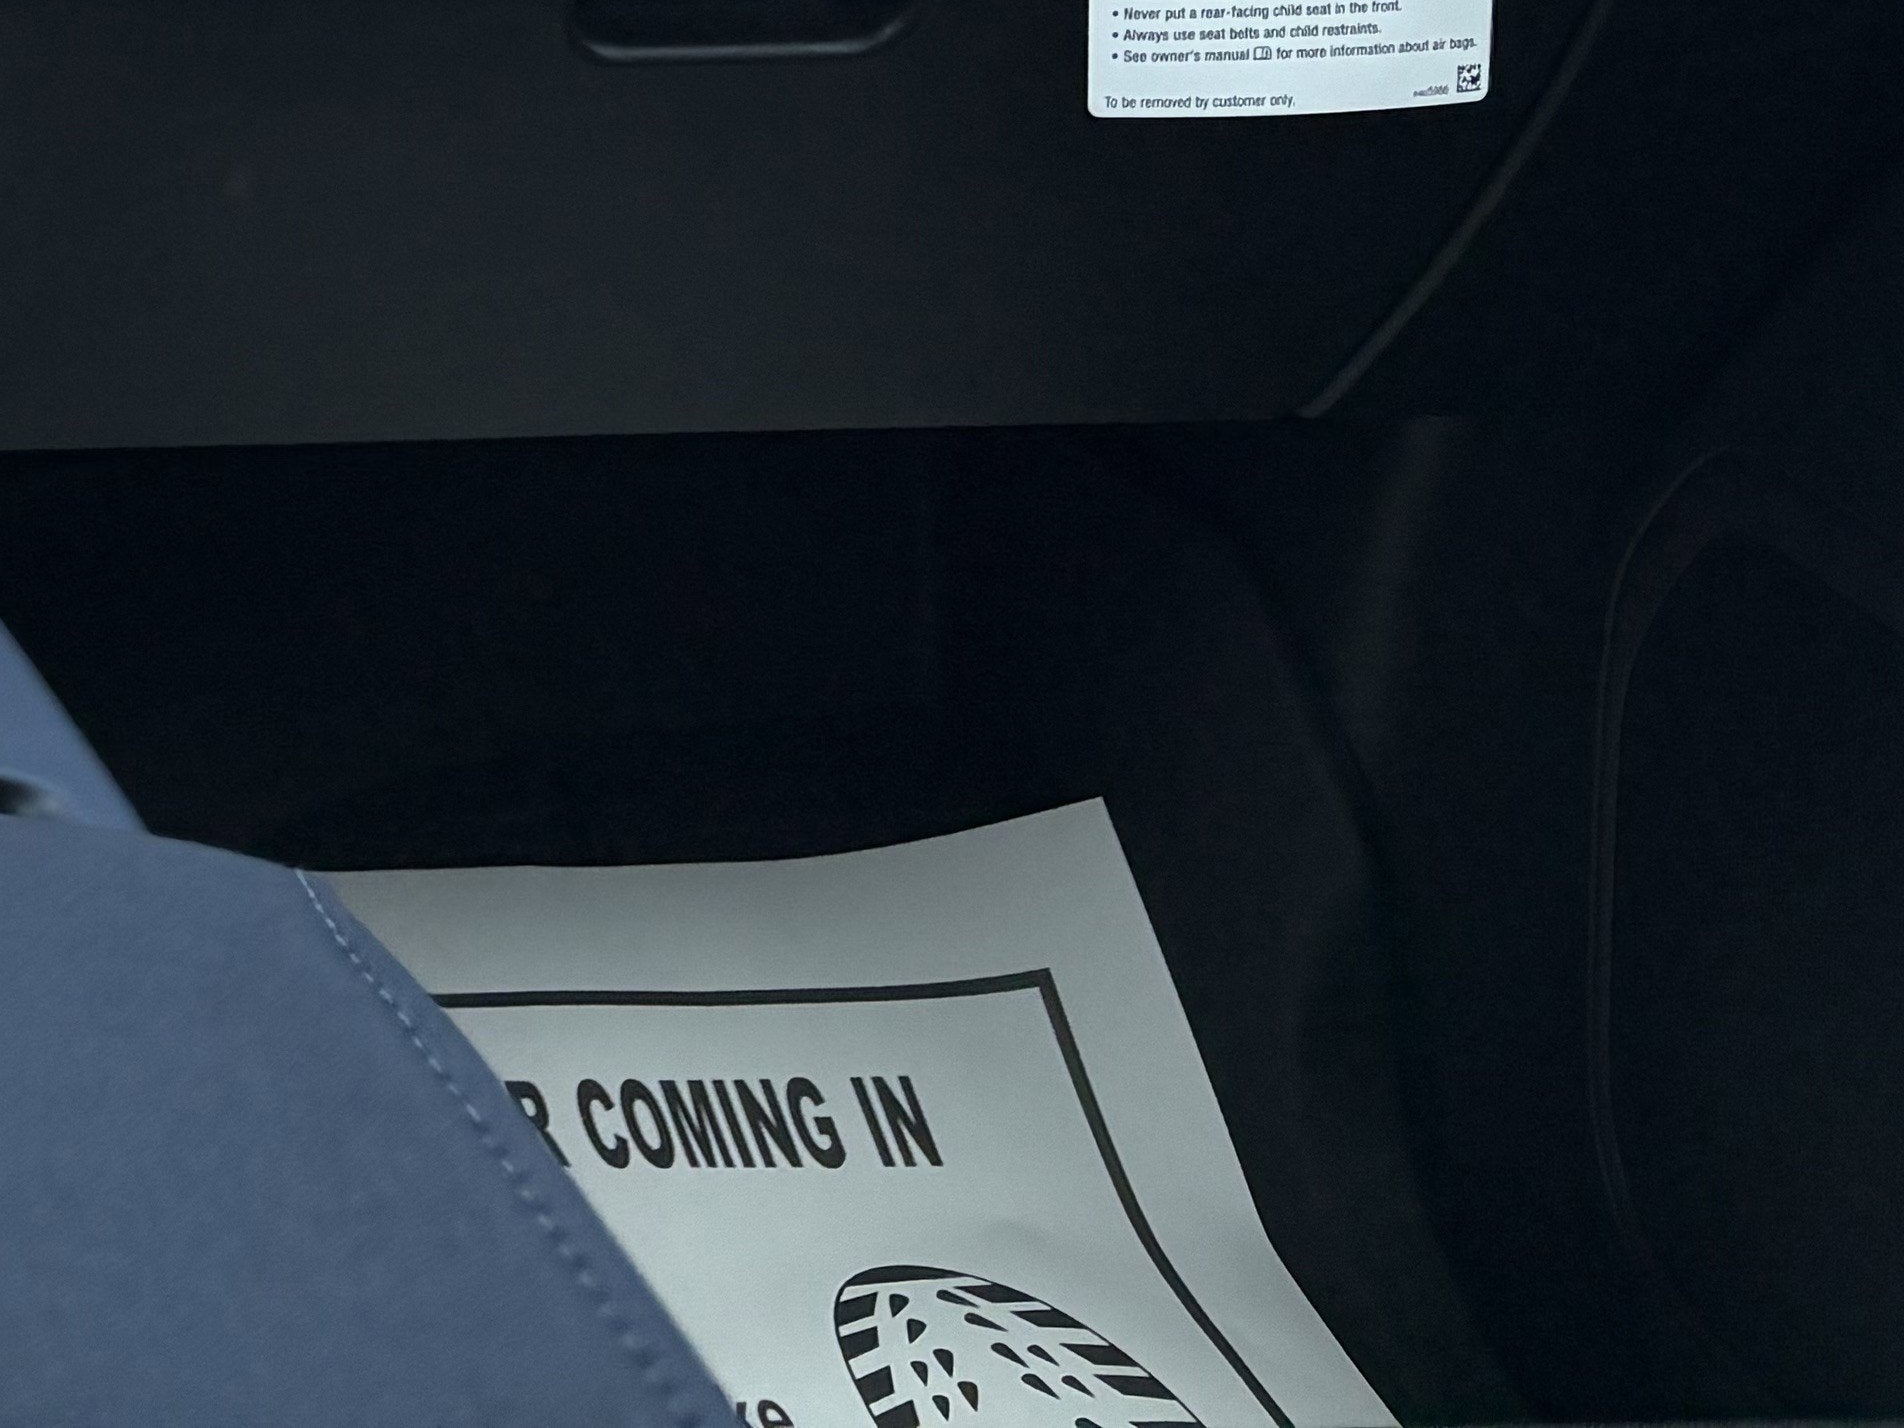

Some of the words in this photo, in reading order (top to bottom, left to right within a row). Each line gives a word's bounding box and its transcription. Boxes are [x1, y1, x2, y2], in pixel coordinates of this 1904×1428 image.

[1124, 7, 1161, 20] Never
[1165, 7, 1185, 22] put
[1201, 4, 1269, 20] rear-facing
[1273, 3, 1302, 17] child
[1306, 3, 1332, 15] seat
[1335, 2, 1345, 14] in
[1349, 1, 1368, 14] the
[1124, 28, 1169, 44] Always
[1173, 30, 1196, 41] use
[1199, 28, 1225, 40] seat
[1230, 27, 1260, 40] belts
[1264, 25, 1286, 38] and
[1290, 24, 1318, 37] child
[1124, 49, 1147, 63] See
[1151, 48, 1201, 62] owner's
[1205, 47, 1249, 61] manual
[1276, 47, 1292, 59] for
[1296, 47, 1327, 59] more
[1330, 42, 1395, 57] information
[1399, 40, 1428, 54] about
[1433, 39, 1446, 51] air
[1105, 96, 1118, 109] To
[1121, 95, 1136, 109] be
[1140, 95, 1192, 108] removed
[1195, 95, 1209, 111] by
[1213, 94, 1266, 108] customer
[577, 1077, 847, 1170] COMING
[850, 1075, 944, 1168] IN
